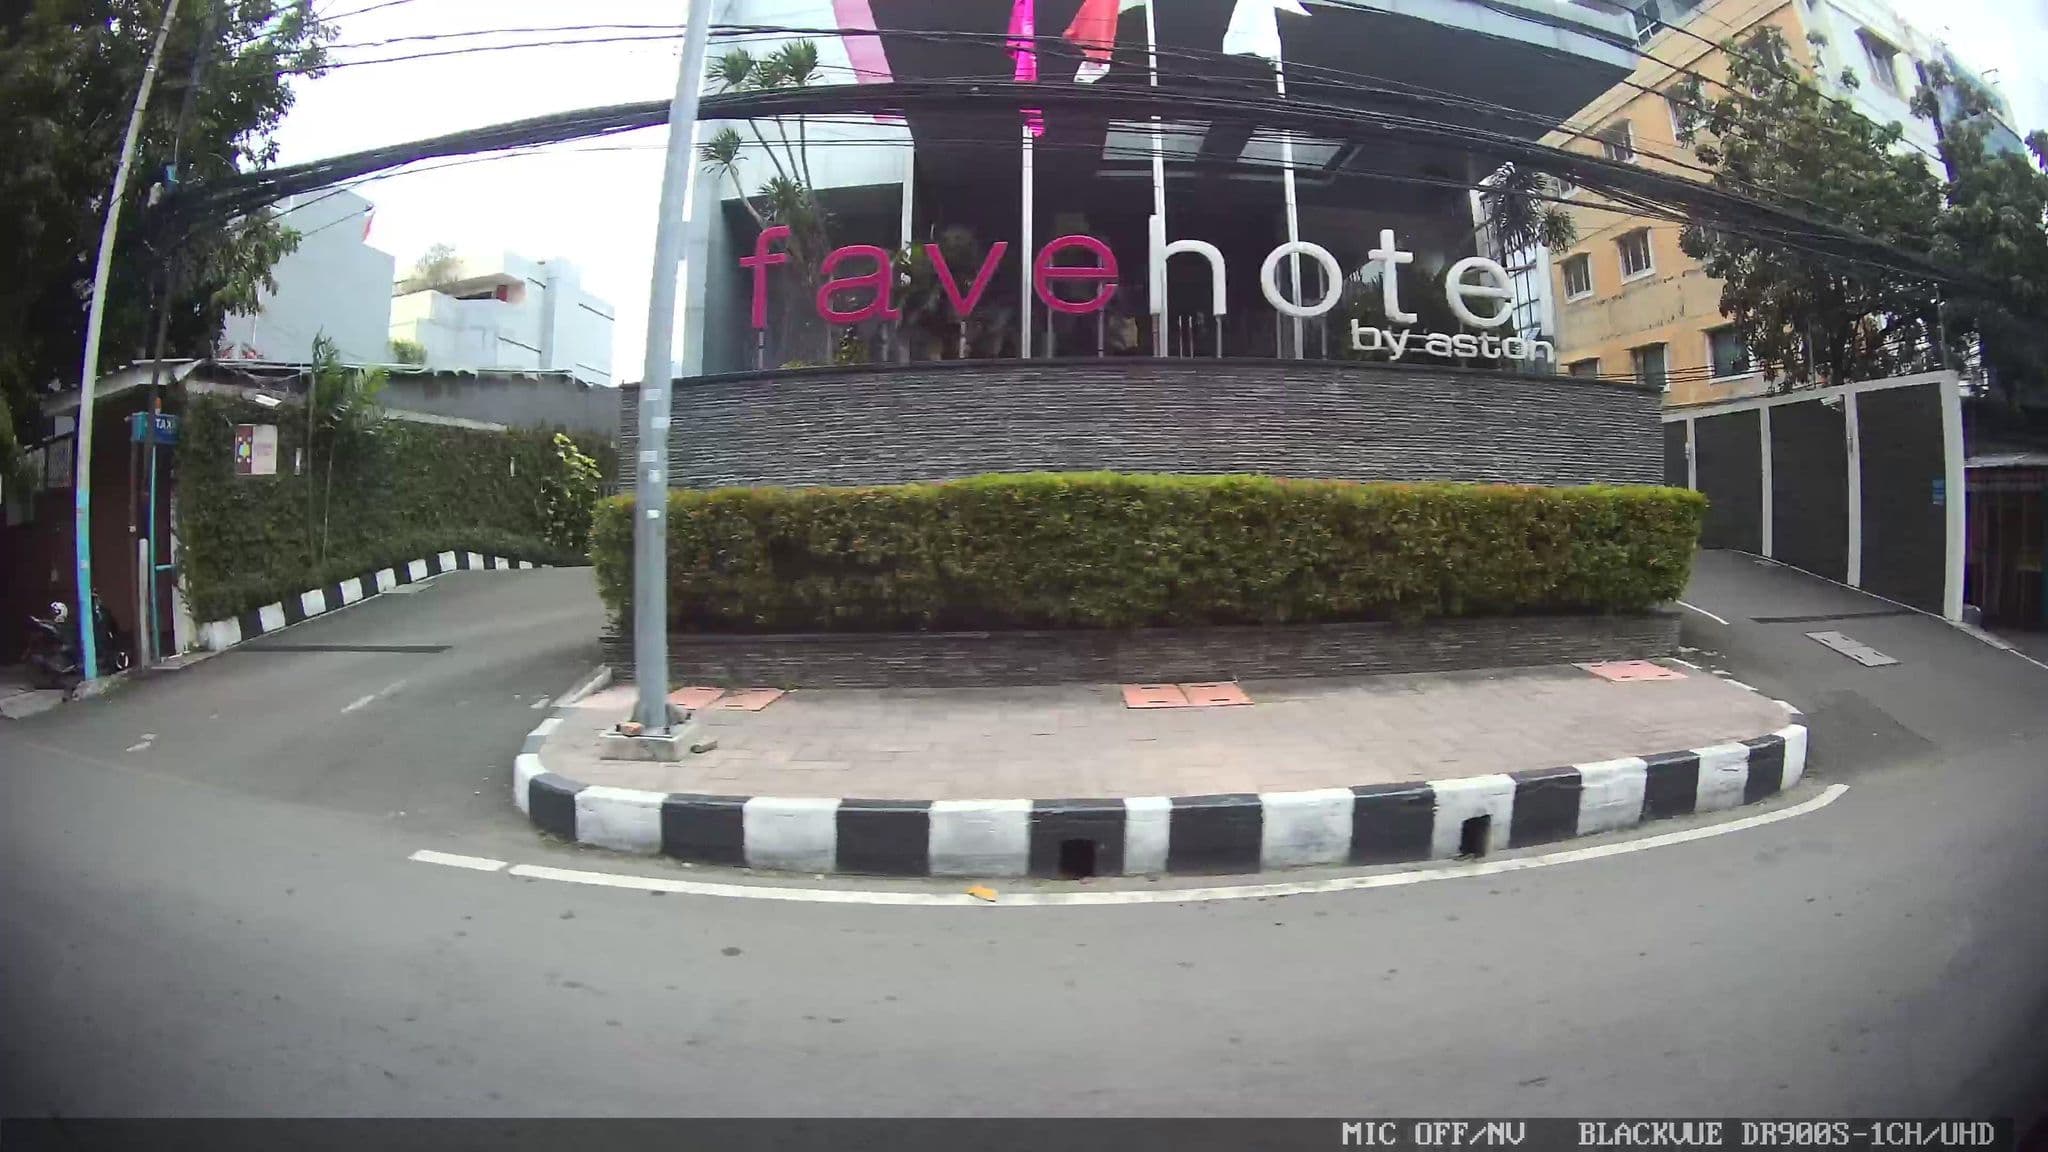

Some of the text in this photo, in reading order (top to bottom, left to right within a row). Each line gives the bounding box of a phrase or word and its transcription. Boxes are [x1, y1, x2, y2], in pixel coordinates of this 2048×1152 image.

[740, 215, 1513, 328] favehote
[1351, 319, 1554, 363] by aston
